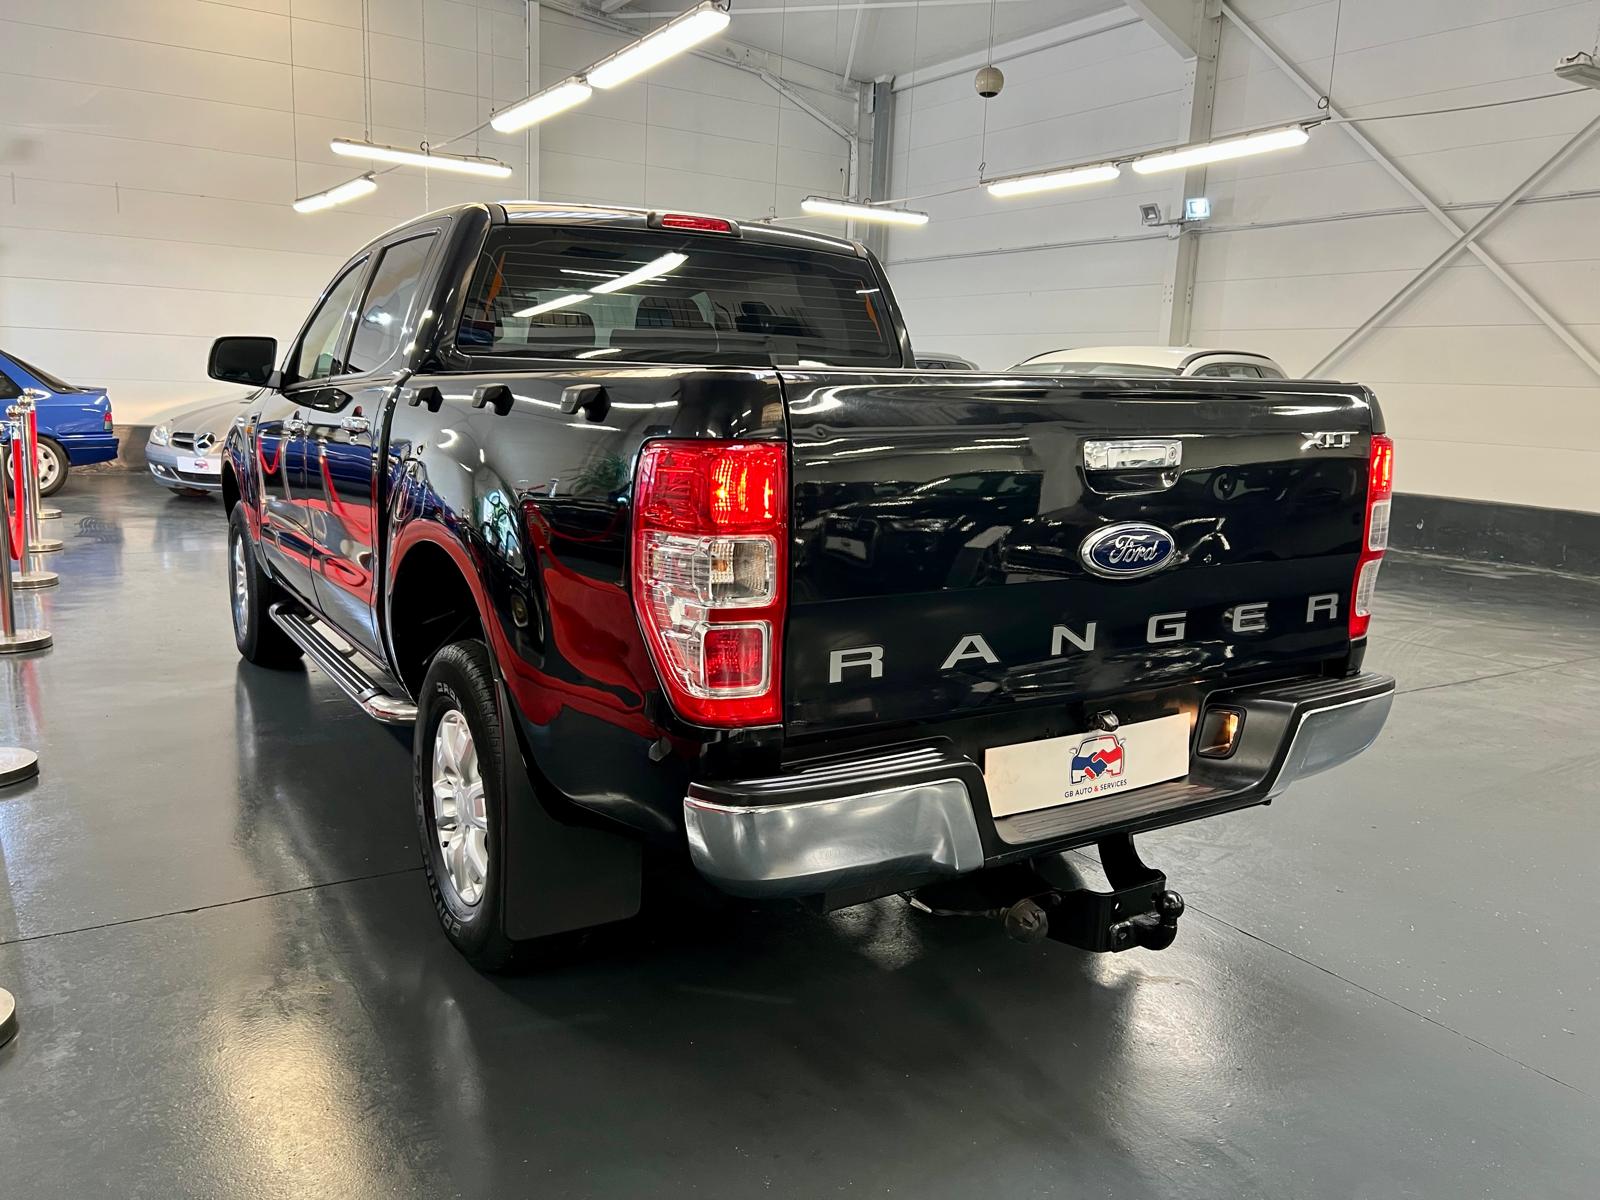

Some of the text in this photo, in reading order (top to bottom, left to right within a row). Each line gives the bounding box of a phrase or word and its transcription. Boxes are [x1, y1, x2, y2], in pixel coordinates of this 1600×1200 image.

[1300, 431, 1360, 450] XLT
[1108, 534, 1159, 564] Ford
[829, 593, 1339, 683] RANGER
[1064, 790, 1074, 798] GB
[1075, 786, 1093, 796] AUTO
[1100, 779, 1127, 791] SERVICES
